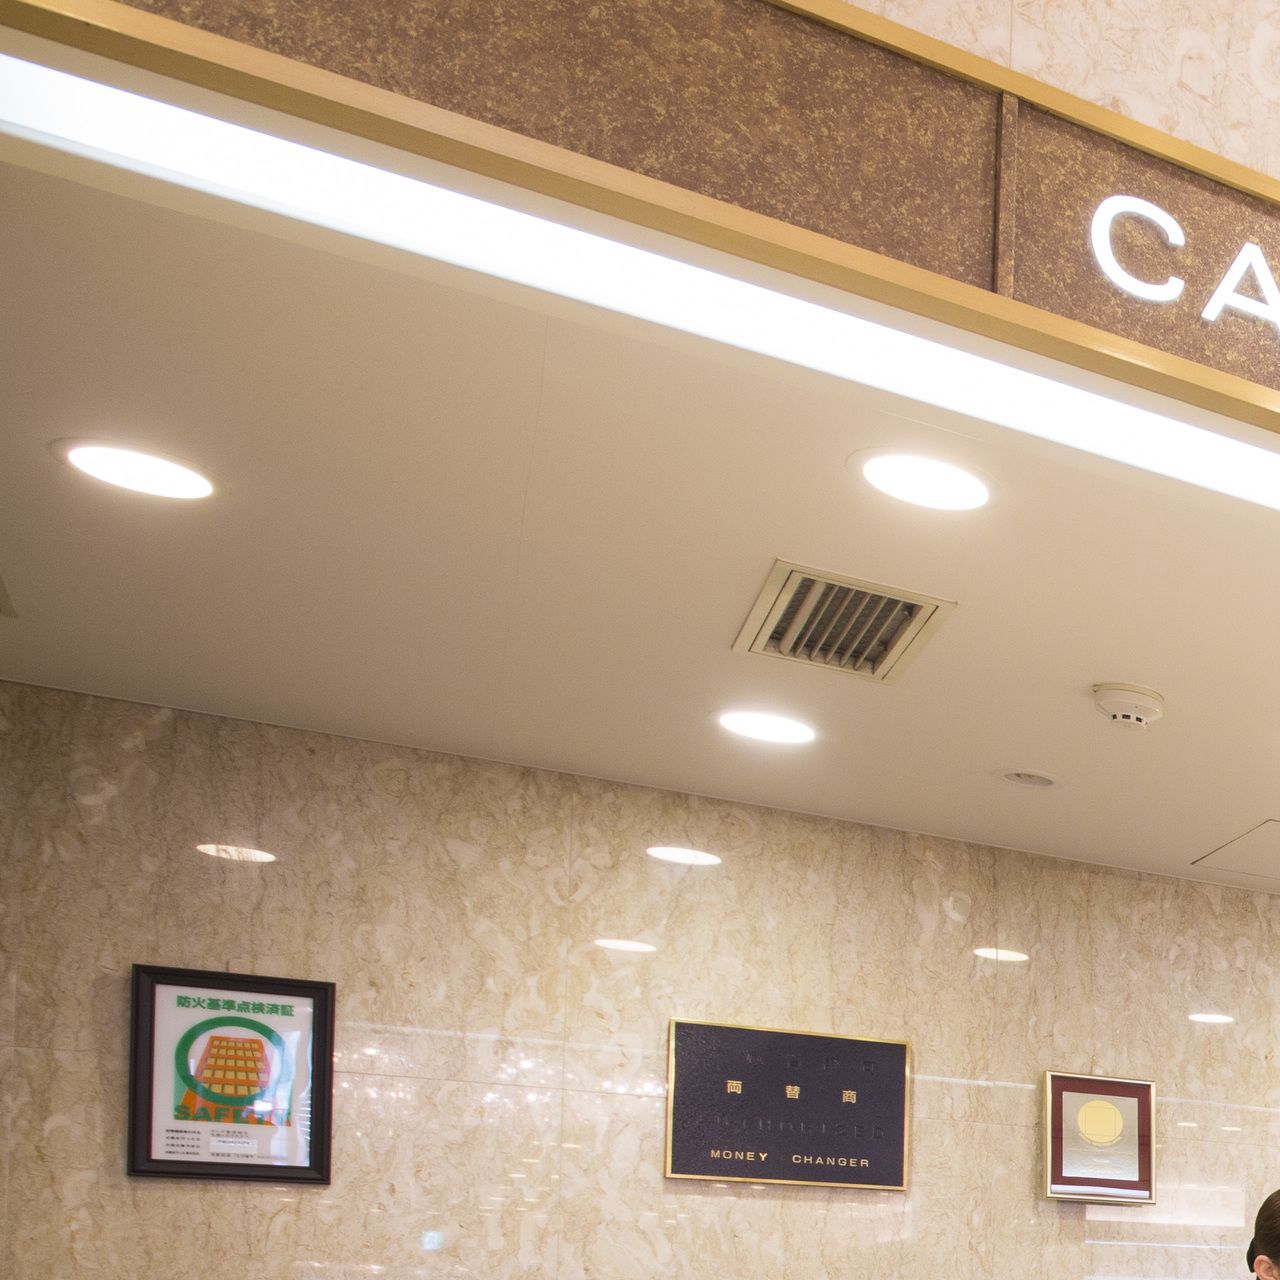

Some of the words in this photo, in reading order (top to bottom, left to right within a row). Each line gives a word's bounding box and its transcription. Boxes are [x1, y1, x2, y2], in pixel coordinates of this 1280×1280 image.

[176, 995, 295, 1017] 防火基準点検済証
[726, 1080, 857, 1104] 両替商
[710, 1149, 768, 1162] MONEY
[791, 1154, 870, 1168] CHANGER
